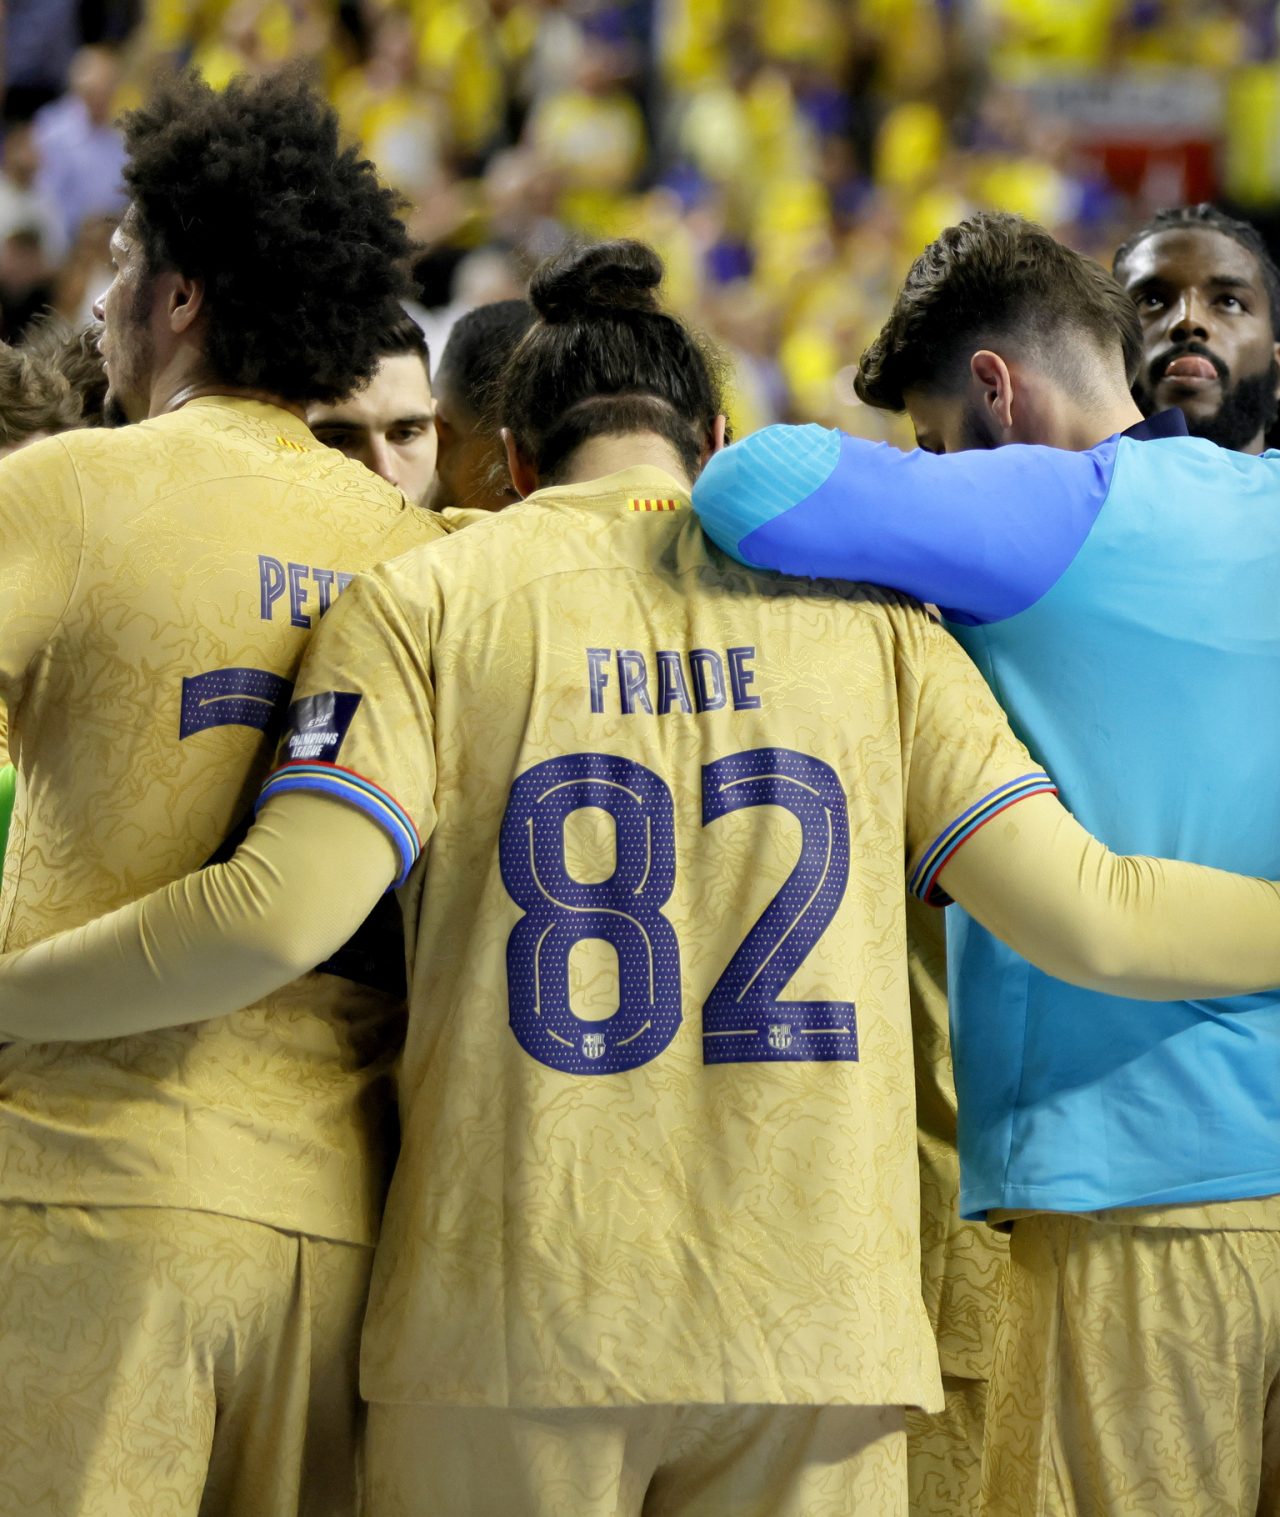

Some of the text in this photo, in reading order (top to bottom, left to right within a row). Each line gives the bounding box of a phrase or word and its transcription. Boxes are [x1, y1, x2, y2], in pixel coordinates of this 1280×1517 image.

[585, 646, 761, 716] FRADE
[289, 732, 339, 748] CHAMPIONS
[291, 745, 324, 759] LEAGUE
[500, 747, 860, 1076] 82
